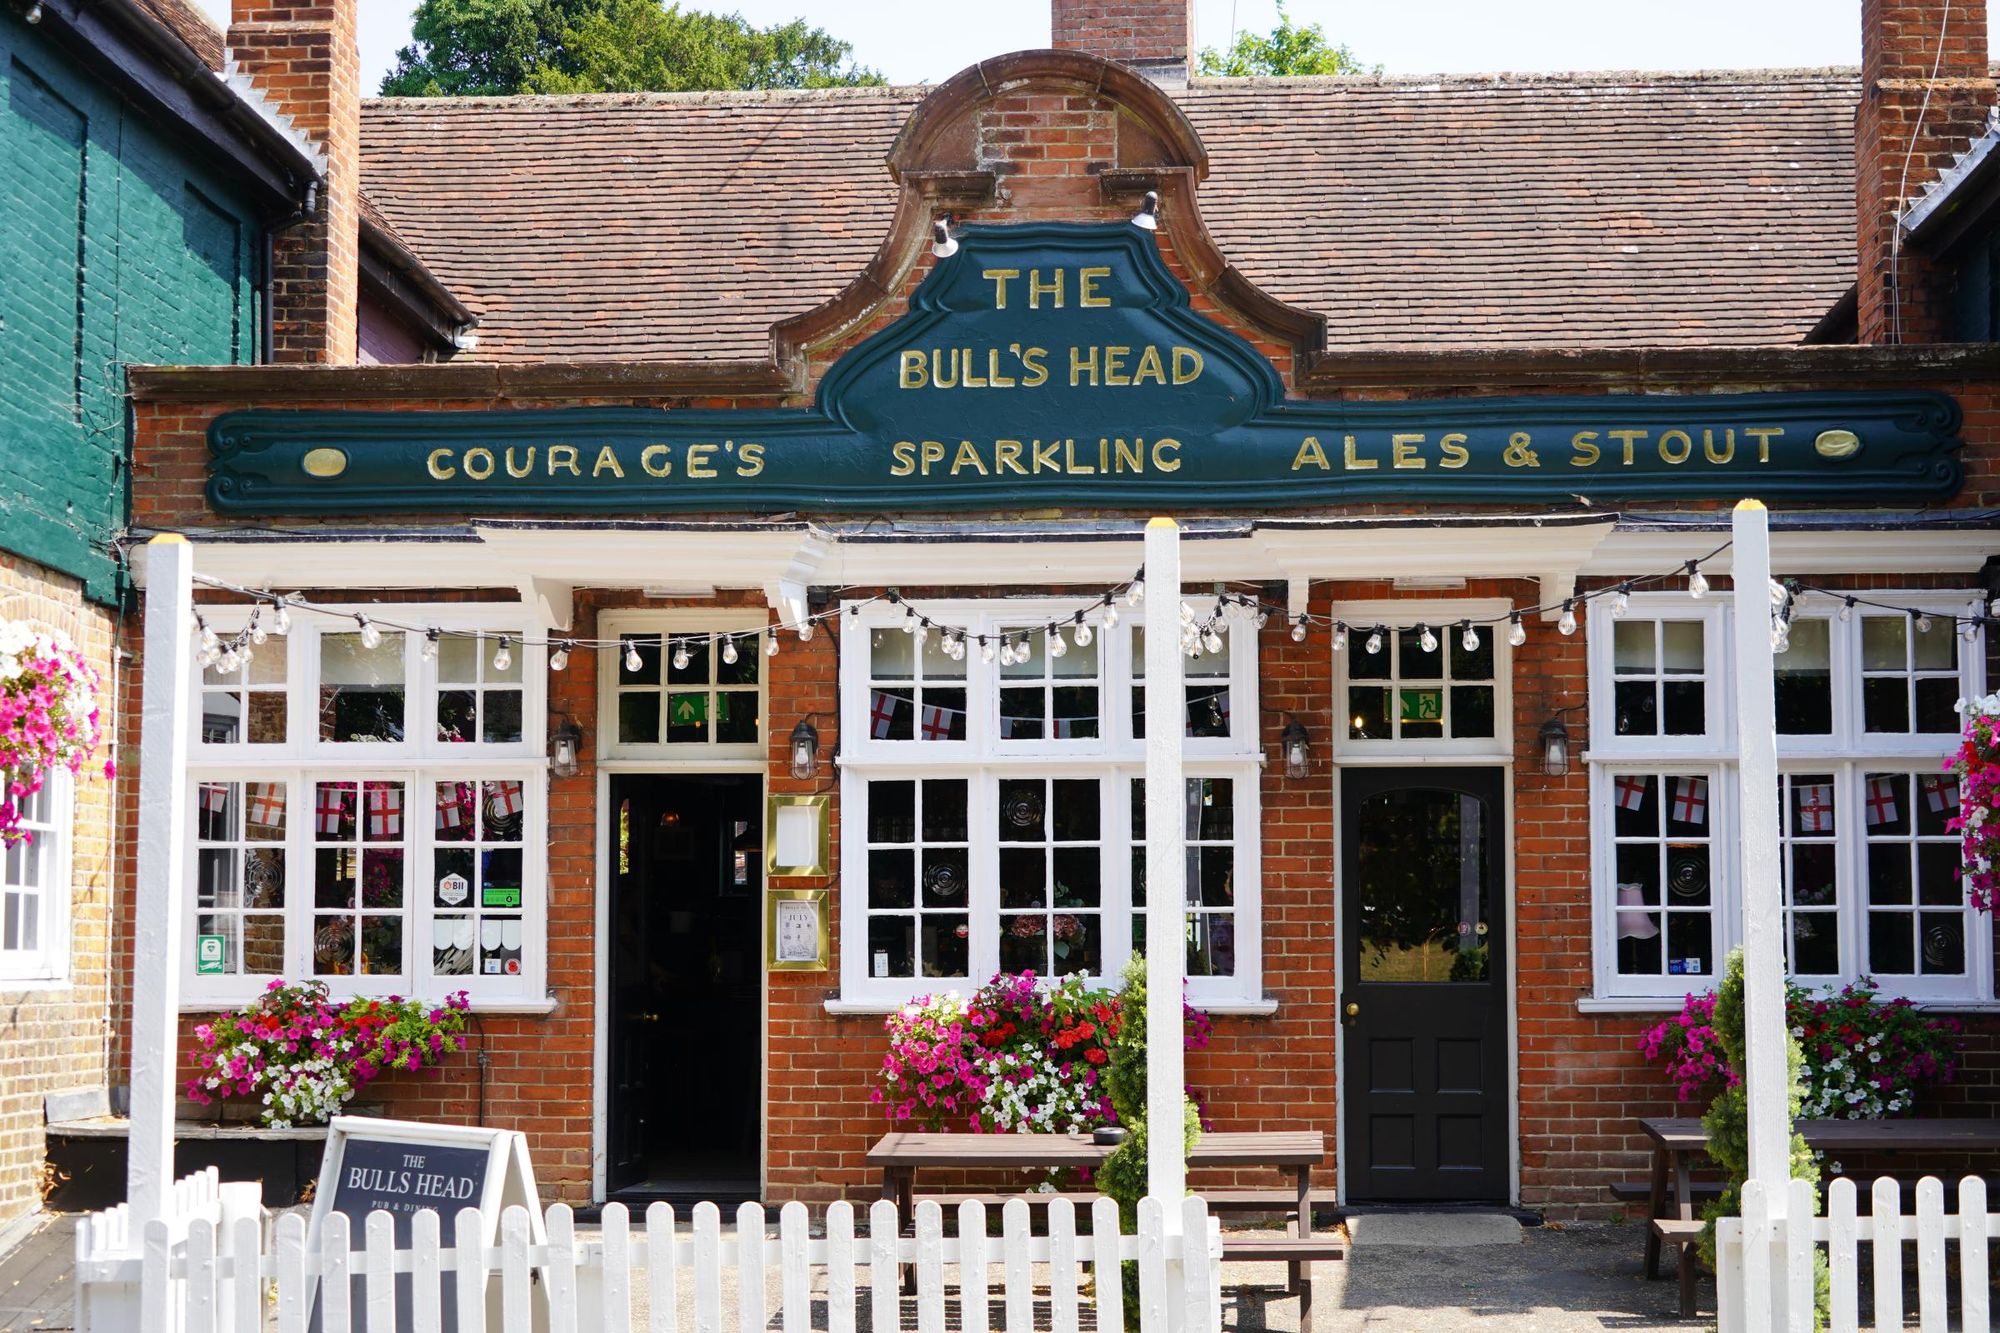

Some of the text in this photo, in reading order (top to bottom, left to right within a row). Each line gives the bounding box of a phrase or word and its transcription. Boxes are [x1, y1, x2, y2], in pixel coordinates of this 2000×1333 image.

[982, 267, 1112, 310] THE
[899, 343, 1205, 389] BULL'S HEAD
[426, 427, 1786, 482] COURAGE'S SPARKLING ALES & STOUT
[788, 914, 809, 922] JULY
[403, 1154, 426, 1169] THE
[347, 1167, 474, 1200] BULLS HEAD
[371, 1200, 390, 1210] PUB
